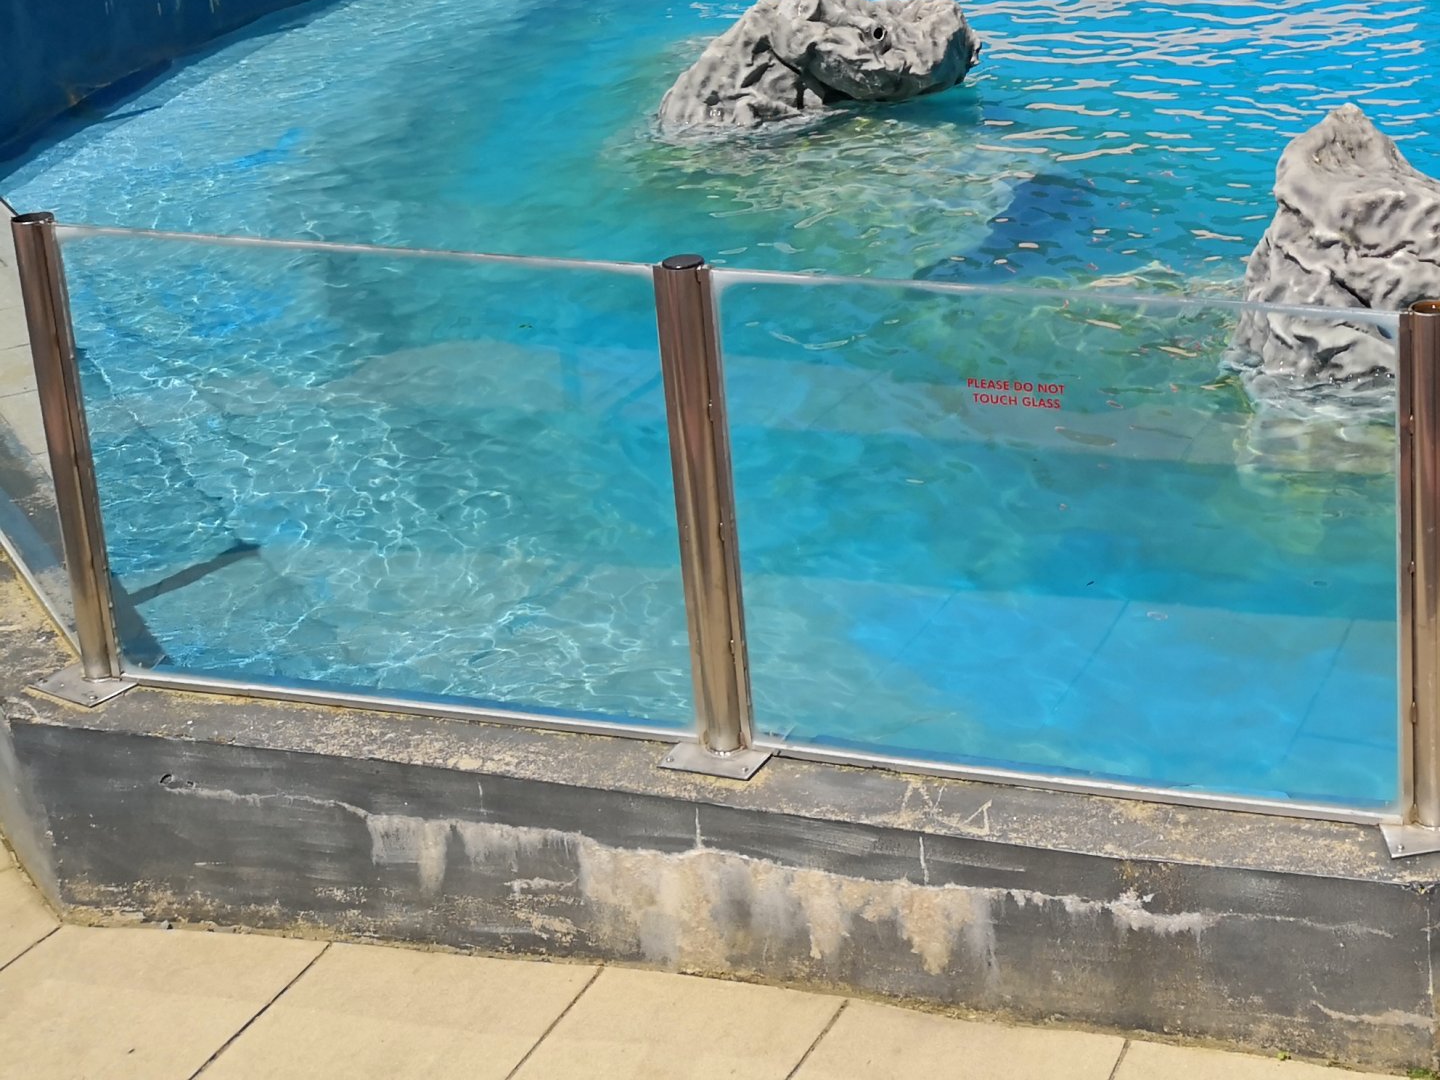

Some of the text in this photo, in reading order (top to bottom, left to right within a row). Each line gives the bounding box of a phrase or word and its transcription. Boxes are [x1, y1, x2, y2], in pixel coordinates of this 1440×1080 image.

[967, 378, 1065, 394] PLEASE DO NOT
[973, 393, 1061, 409] TOUCH GLASS
